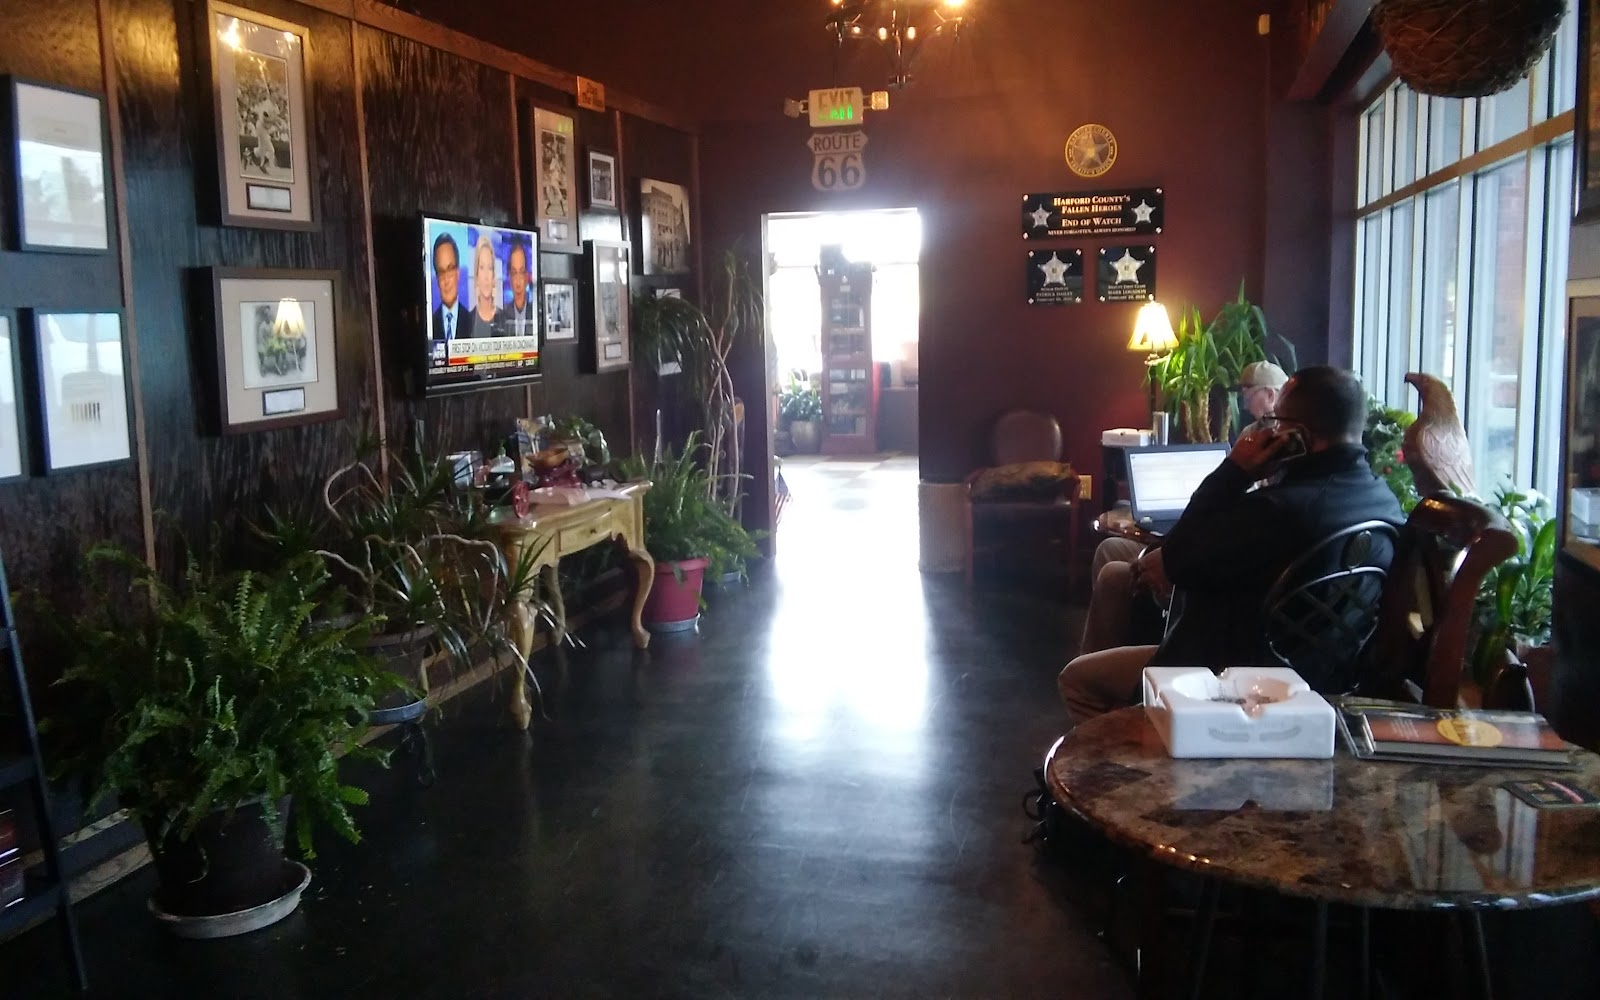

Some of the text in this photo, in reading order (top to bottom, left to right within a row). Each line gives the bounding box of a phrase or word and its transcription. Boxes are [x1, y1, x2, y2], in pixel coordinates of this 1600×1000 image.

[818, 89, 854, 120] EXIT
[814, 134, 861, 151] ROUTE
[818, 154, 860, 188] 66
[1053, 197, 1091, 206] HARFORD
[1061, 204, 1122, 214] FALLEN HEROES
[1061, 217, 1122, 227] END OF WATCH
